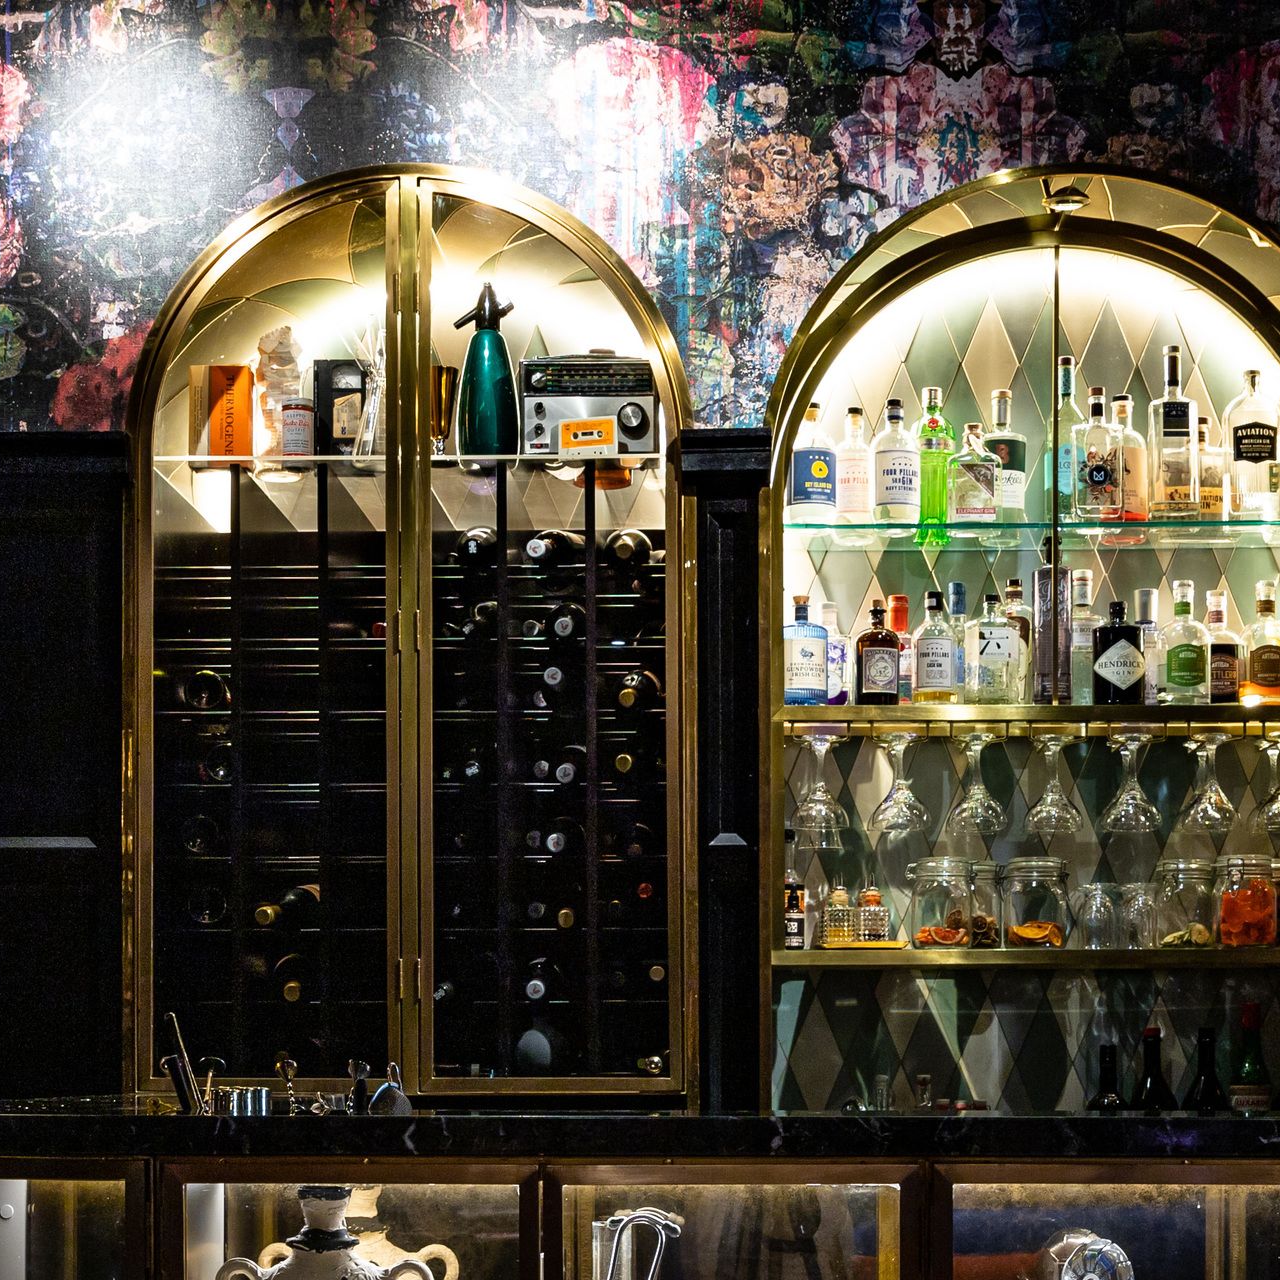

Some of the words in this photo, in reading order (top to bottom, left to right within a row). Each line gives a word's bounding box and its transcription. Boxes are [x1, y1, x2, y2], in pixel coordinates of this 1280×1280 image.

[224, 375, 235, 456] THERMOGENE
[1236, 428, 1275, 437] AVIATION
[883, 468, 897, 476] FOUR
[902, 476, 913, 485] GIN
